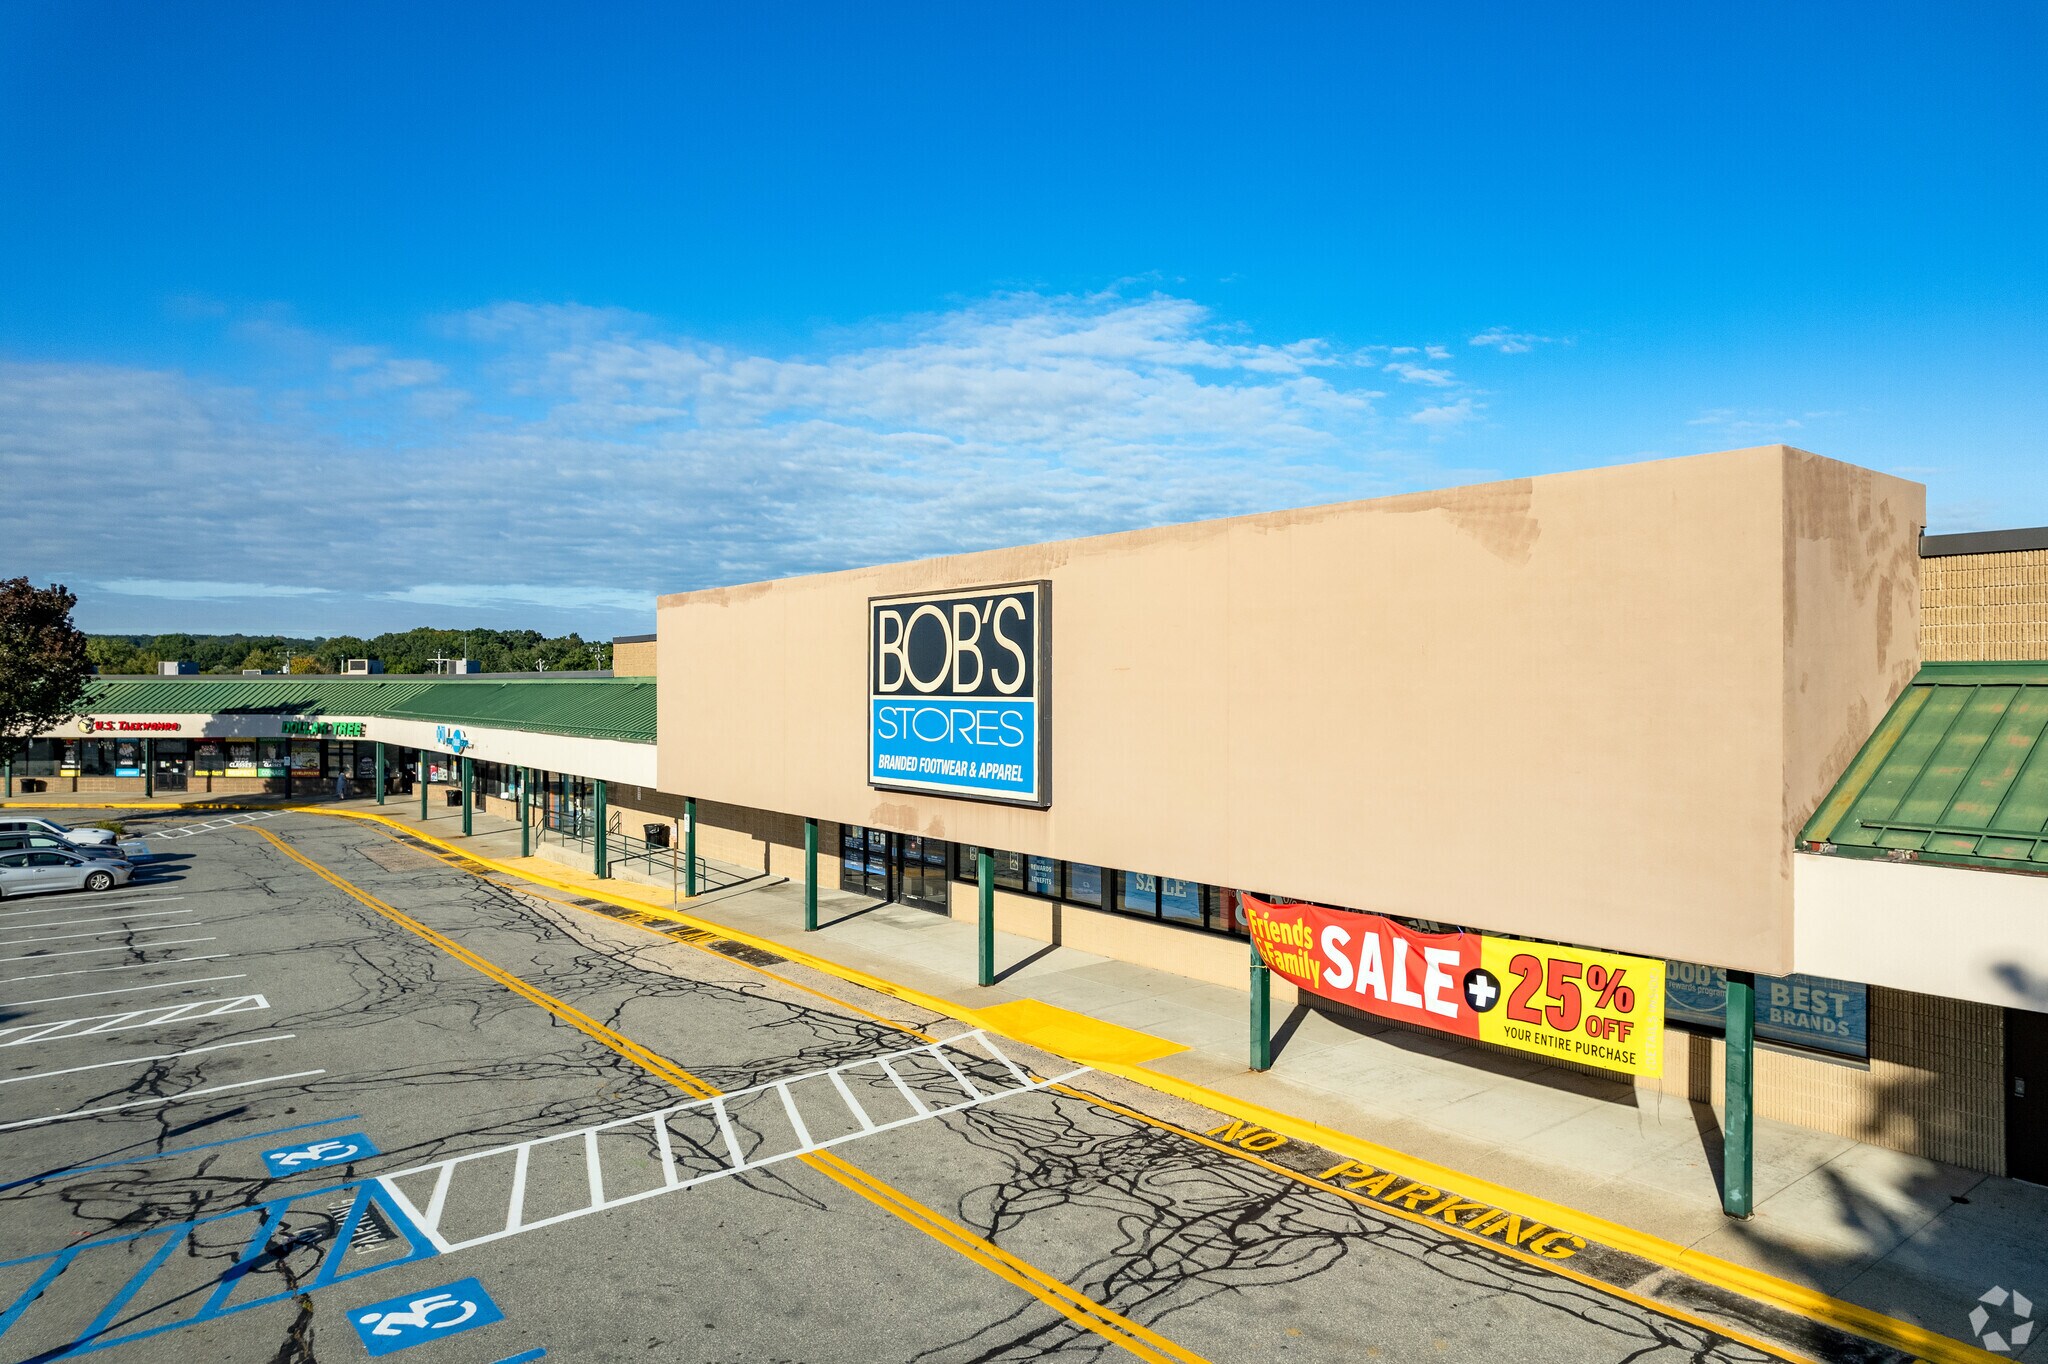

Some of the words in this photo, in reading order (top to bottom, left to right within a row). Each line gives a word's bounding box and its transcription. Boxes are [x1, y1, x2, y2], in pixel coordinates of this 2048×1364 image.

[879, 597, 1026, 694] BOB'S
[95, 721, 116, 731] U.S.
[282, 721, 329, 735] DOLLAR
[332, 721, 363, 736] TREE
[878, 706, 1025, 747] STORES
[878, 754, 918, 772] BRANDED
[919, 757, 968, 776] FOOTWEAR
[969, 763, 977, 778] &
[978, 762, 1024, 782] APPAREL
[1135, 873, 1187, 898] SALE
[1248, 908, 1313, 950] Friends
[1319, 925, 1460, 1019] SALE
[1668, 981, 1696, 993] rewards
[1507, 953, 1635, 1032] 25%
[1770, 982, 1850, 1018] BEST
[1585, 1015, 1634, 1043] OFF
[1769, 1007, 1850, 1036] BRANDS
[1504, 1025, 1532, 1042] YOUR
[1534, 1032, 1572, 1051] ENTIRE
[1575, 1041, 1636, 1065] PURCHASE
[1206, 1120, 1288, 1151] NO
[1318, 1160, 1587, 1259] PARKING
